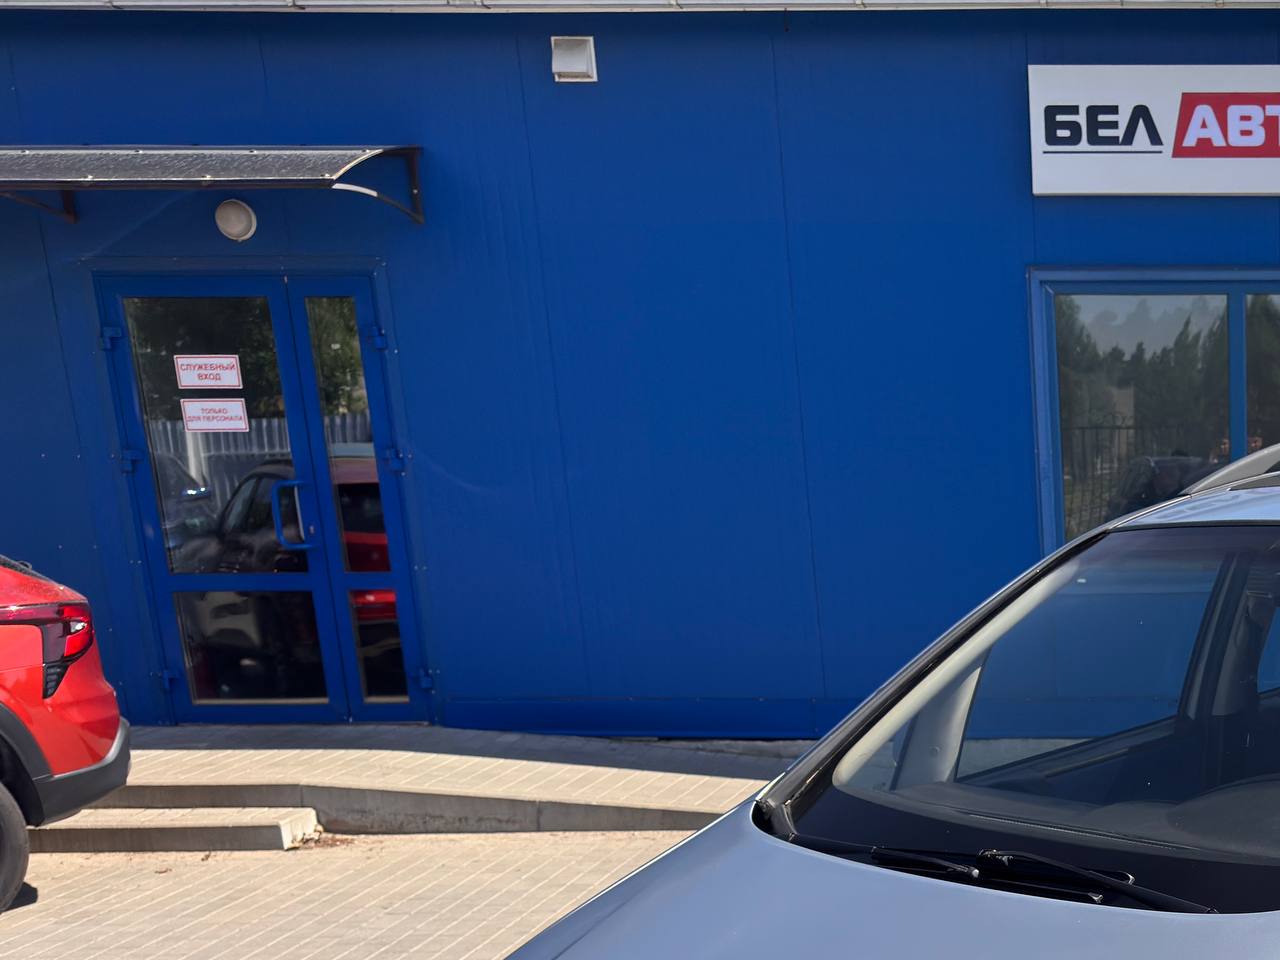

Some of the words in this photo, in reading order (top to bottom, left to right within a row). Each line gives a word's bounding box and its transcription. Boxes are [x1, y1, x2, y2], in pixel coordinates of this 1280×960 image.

[1043, 104, 1164, 146] БЕЛ
[180, 362, 235, 371] СЛУЖЕБНЫЙ
[197, 373, 221, 381] ВХОД
